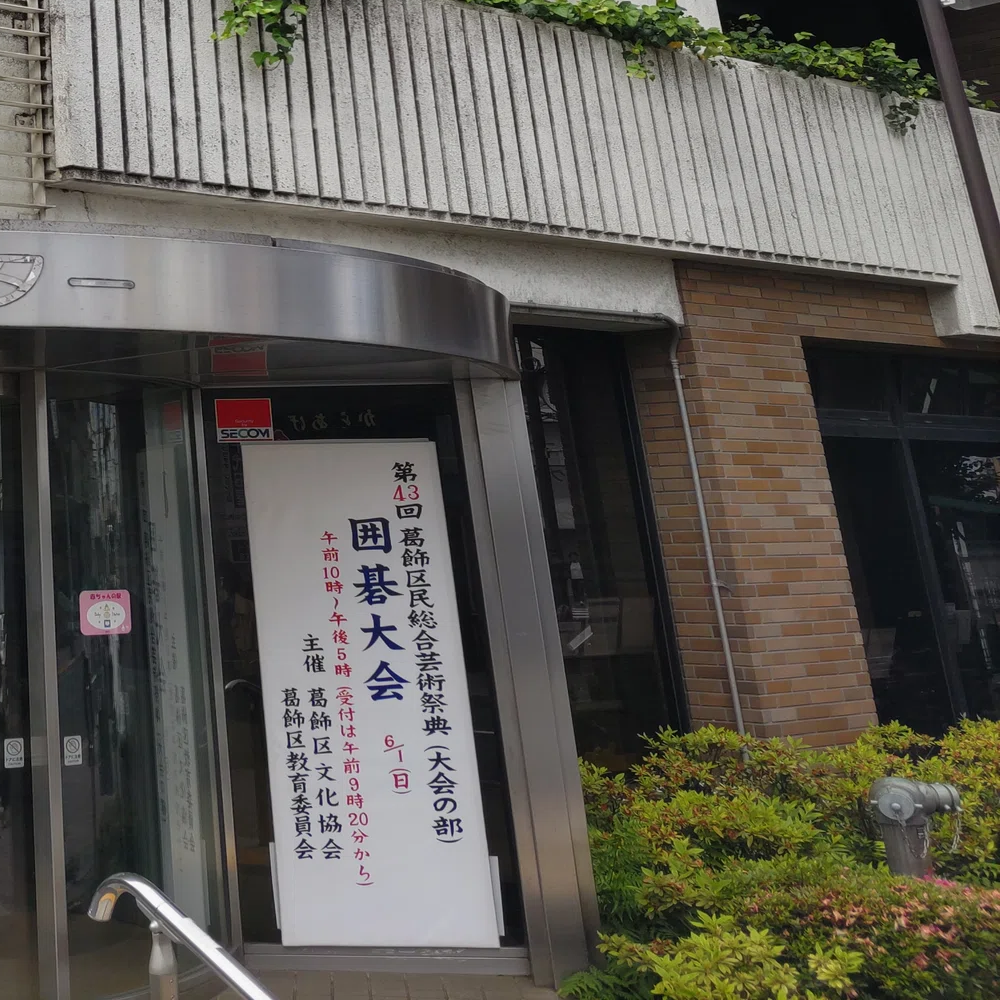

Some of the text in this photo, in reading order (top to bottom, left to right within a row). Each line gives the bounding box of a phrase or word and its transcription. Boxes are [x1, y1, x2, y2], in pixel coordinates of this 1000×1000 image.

[220, 428, 270, 439] SECOM
[348, 517, 411, 701] 囲碁大会
[281, 687, 317, 860] 葛飾区教育委員会
[302, 633, 344, 860] 主催 葛飾区文化協会
